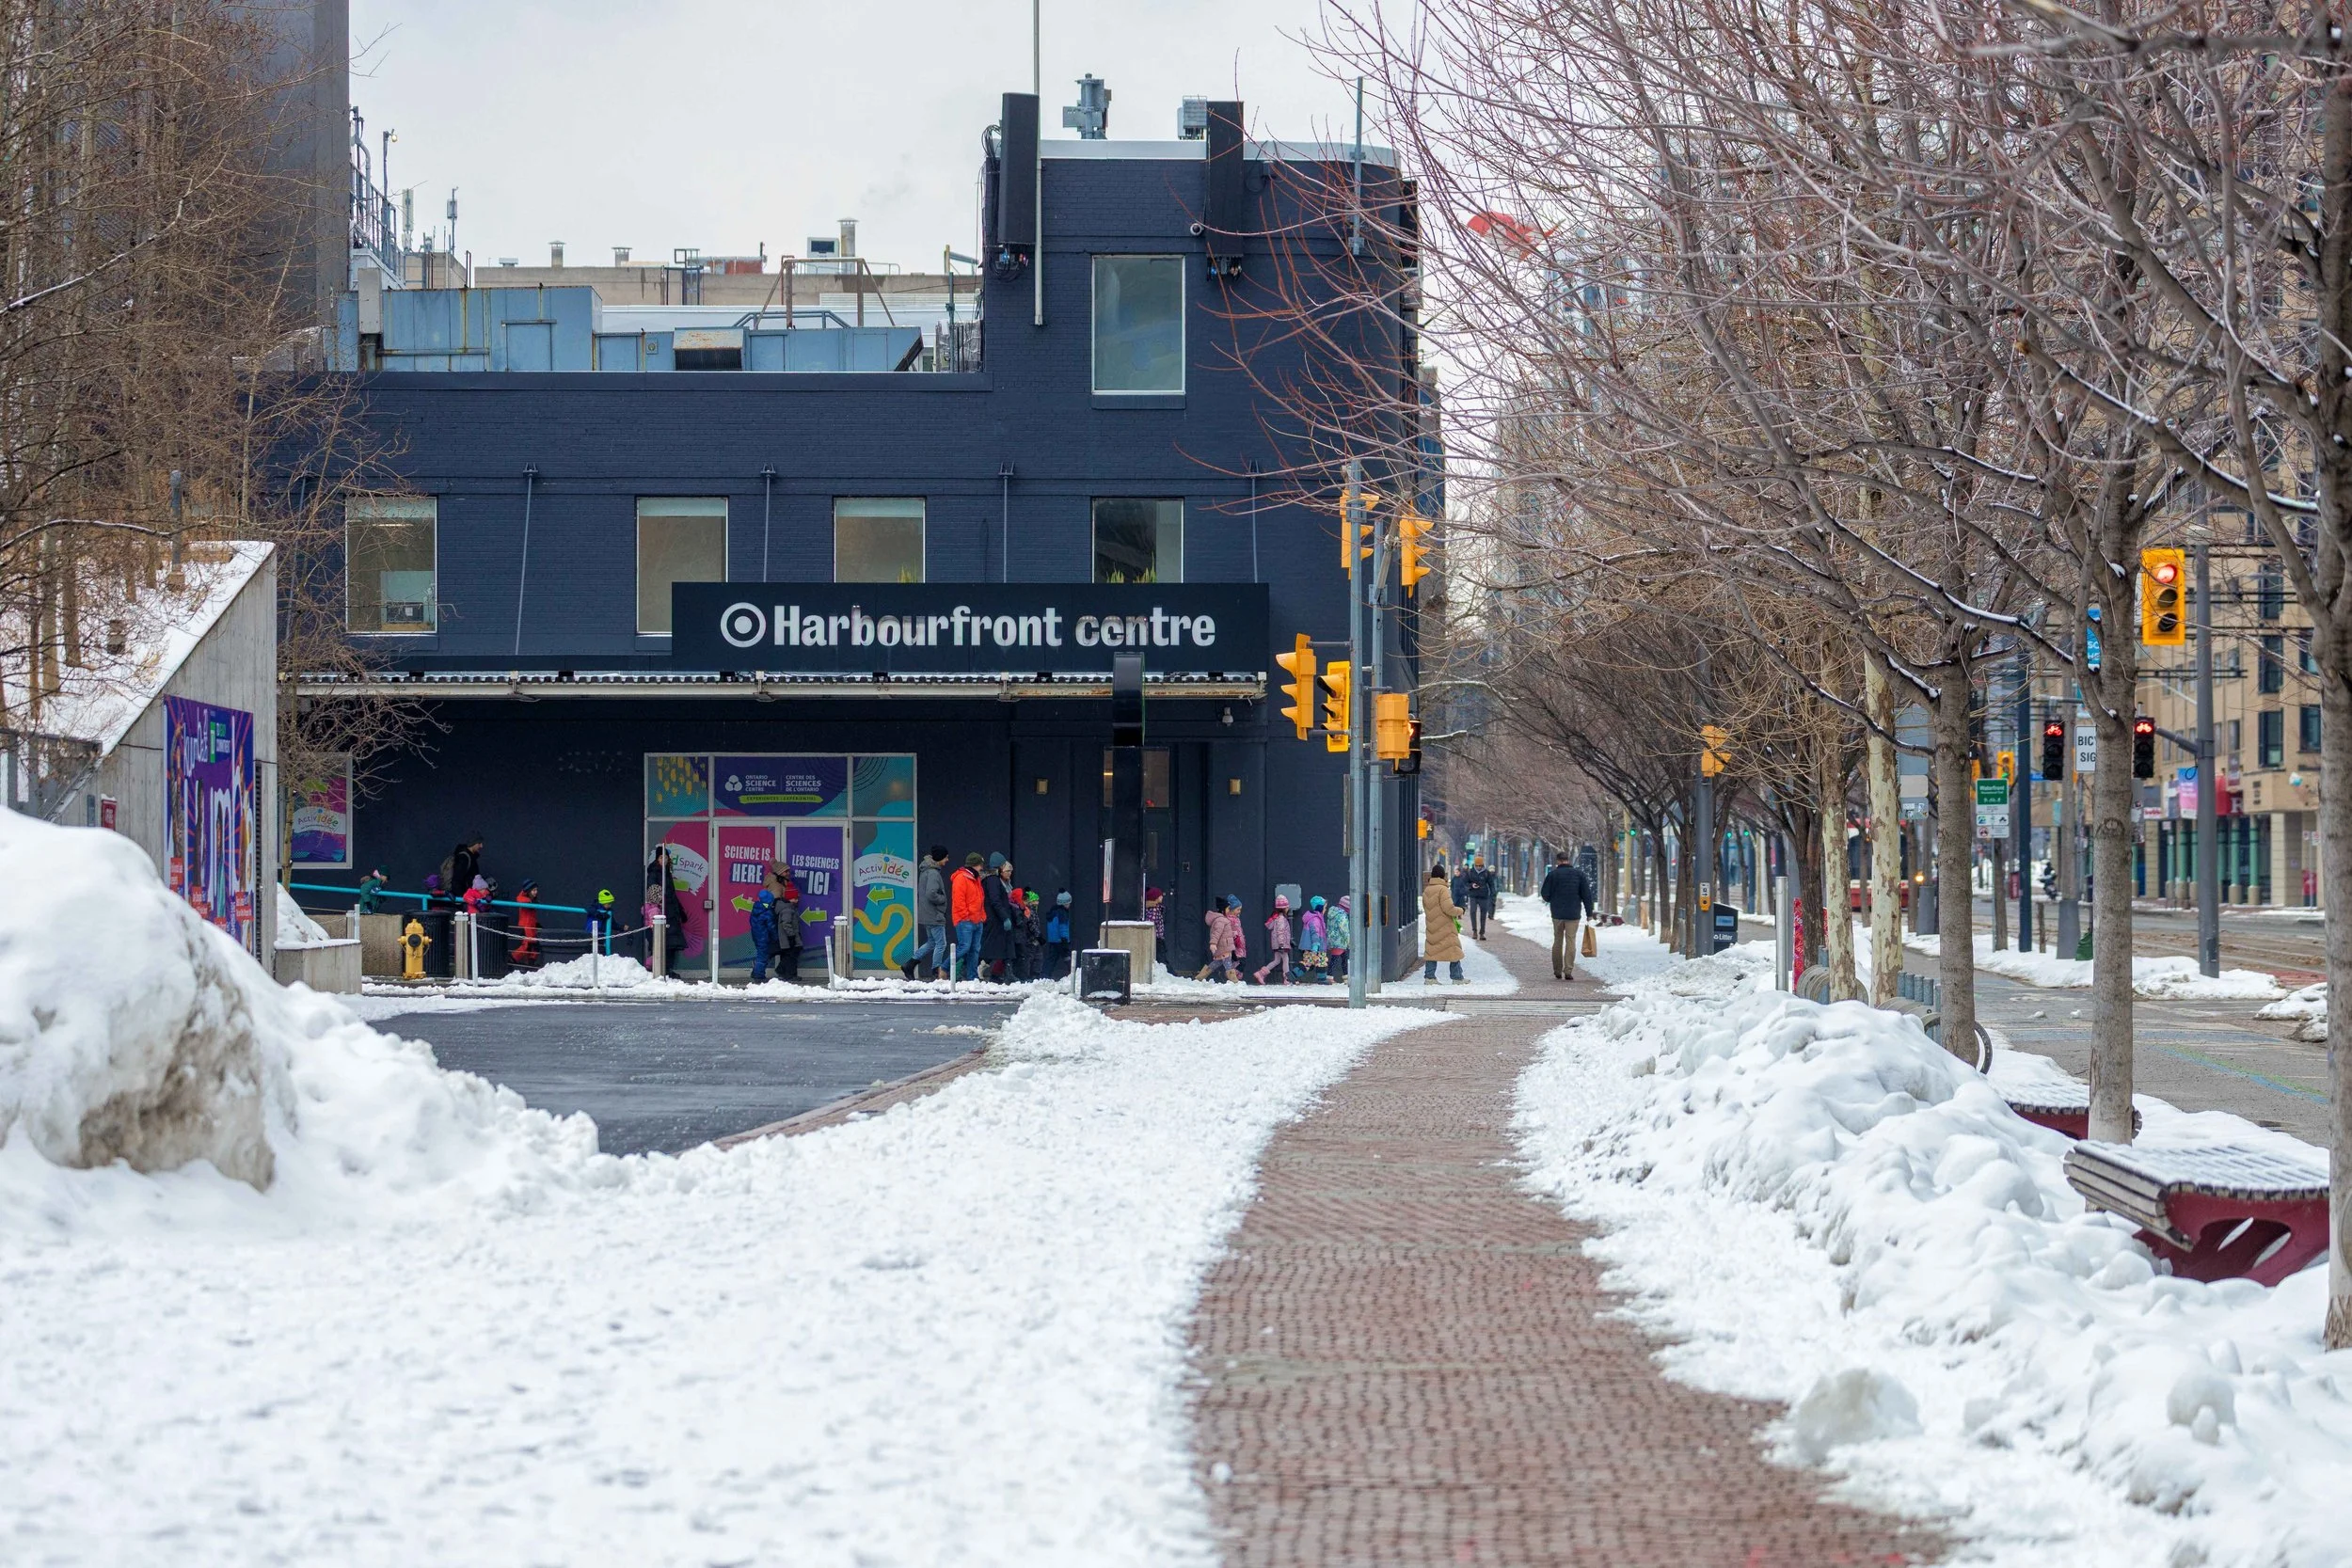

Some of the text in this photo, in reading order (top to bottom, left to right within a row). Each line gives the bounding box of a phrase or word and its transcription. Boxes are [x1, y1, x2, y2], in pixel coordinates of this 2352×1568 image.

[773, 605, 1216, 647] Harbourfront centre
[724, 845, 771, 861] SCIENCE IS
[792, 854, 839, 870] LES SCIENCES
[672, 854, 705, 873] dSpark
[732, 863, 763, 883] HERE
[794, 869, 830, 895] SONT ICI
